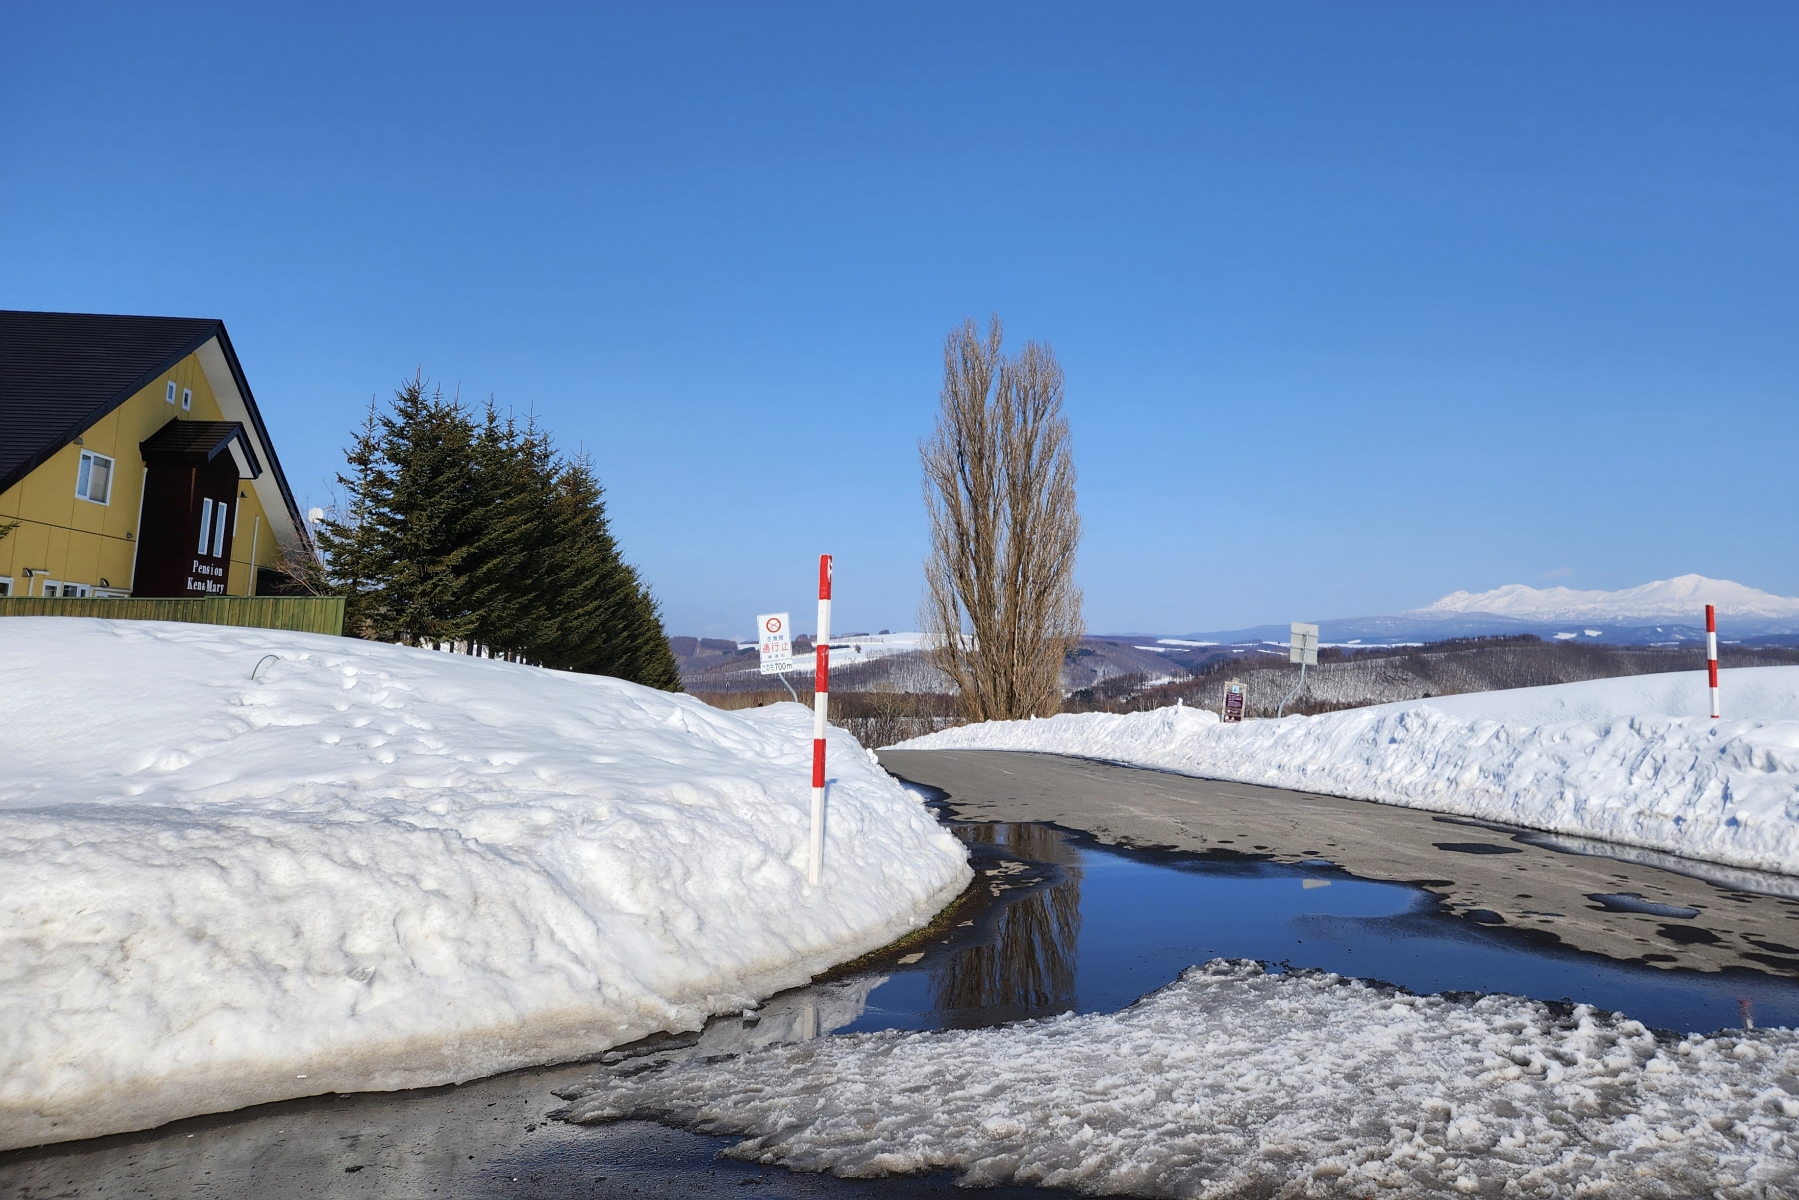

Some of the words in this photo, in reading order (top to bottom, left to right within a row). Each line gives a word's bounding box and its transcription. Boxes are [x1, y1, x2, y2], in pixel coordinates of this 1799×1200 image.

[192, 560, 223, 577] Pension
[187, 577, 225, 594] Ken&Mary
[762, 642, 789, 653] 通行止
